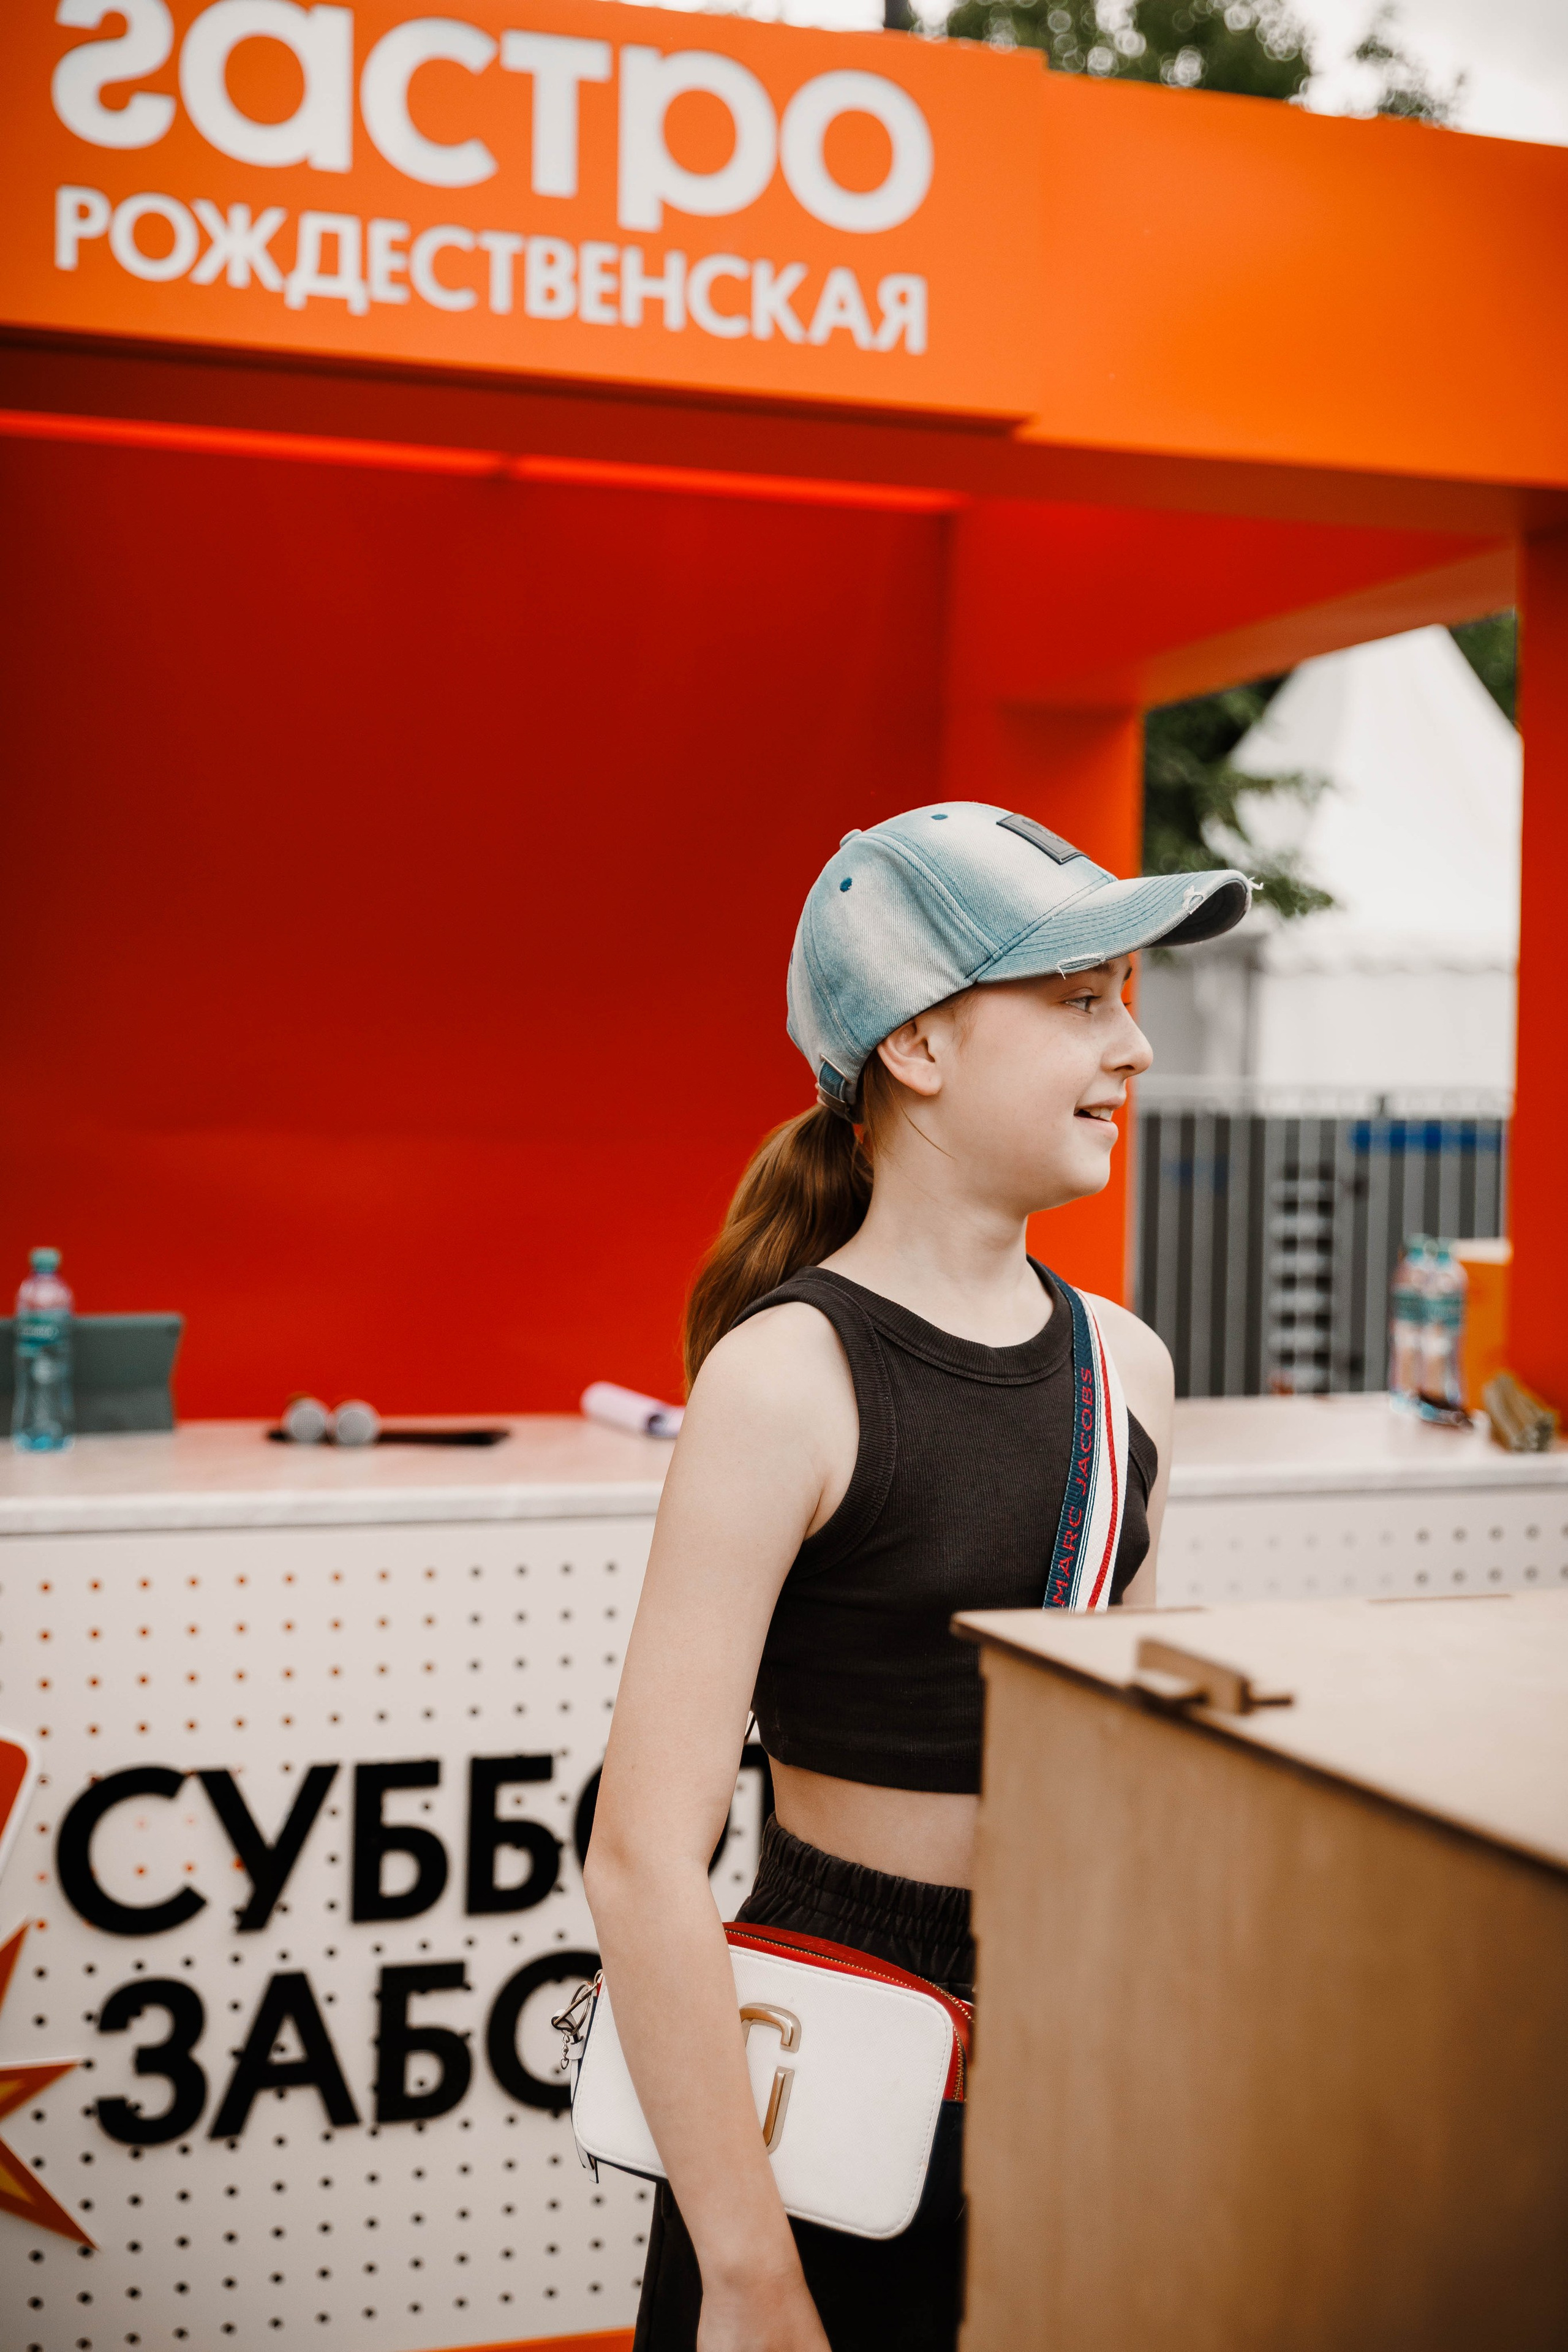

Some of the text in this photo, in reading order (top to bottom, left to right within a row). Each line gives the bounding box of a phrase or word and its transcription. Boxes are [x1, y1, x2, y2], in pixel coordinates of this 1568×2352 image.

[55, 185, 927, 355] РОЖДЕСТВЕНСКАЯ
[1052, 1368, 1094, 1605] MARC JACOBS
[55, 1743, 775, 1937] СУББ
